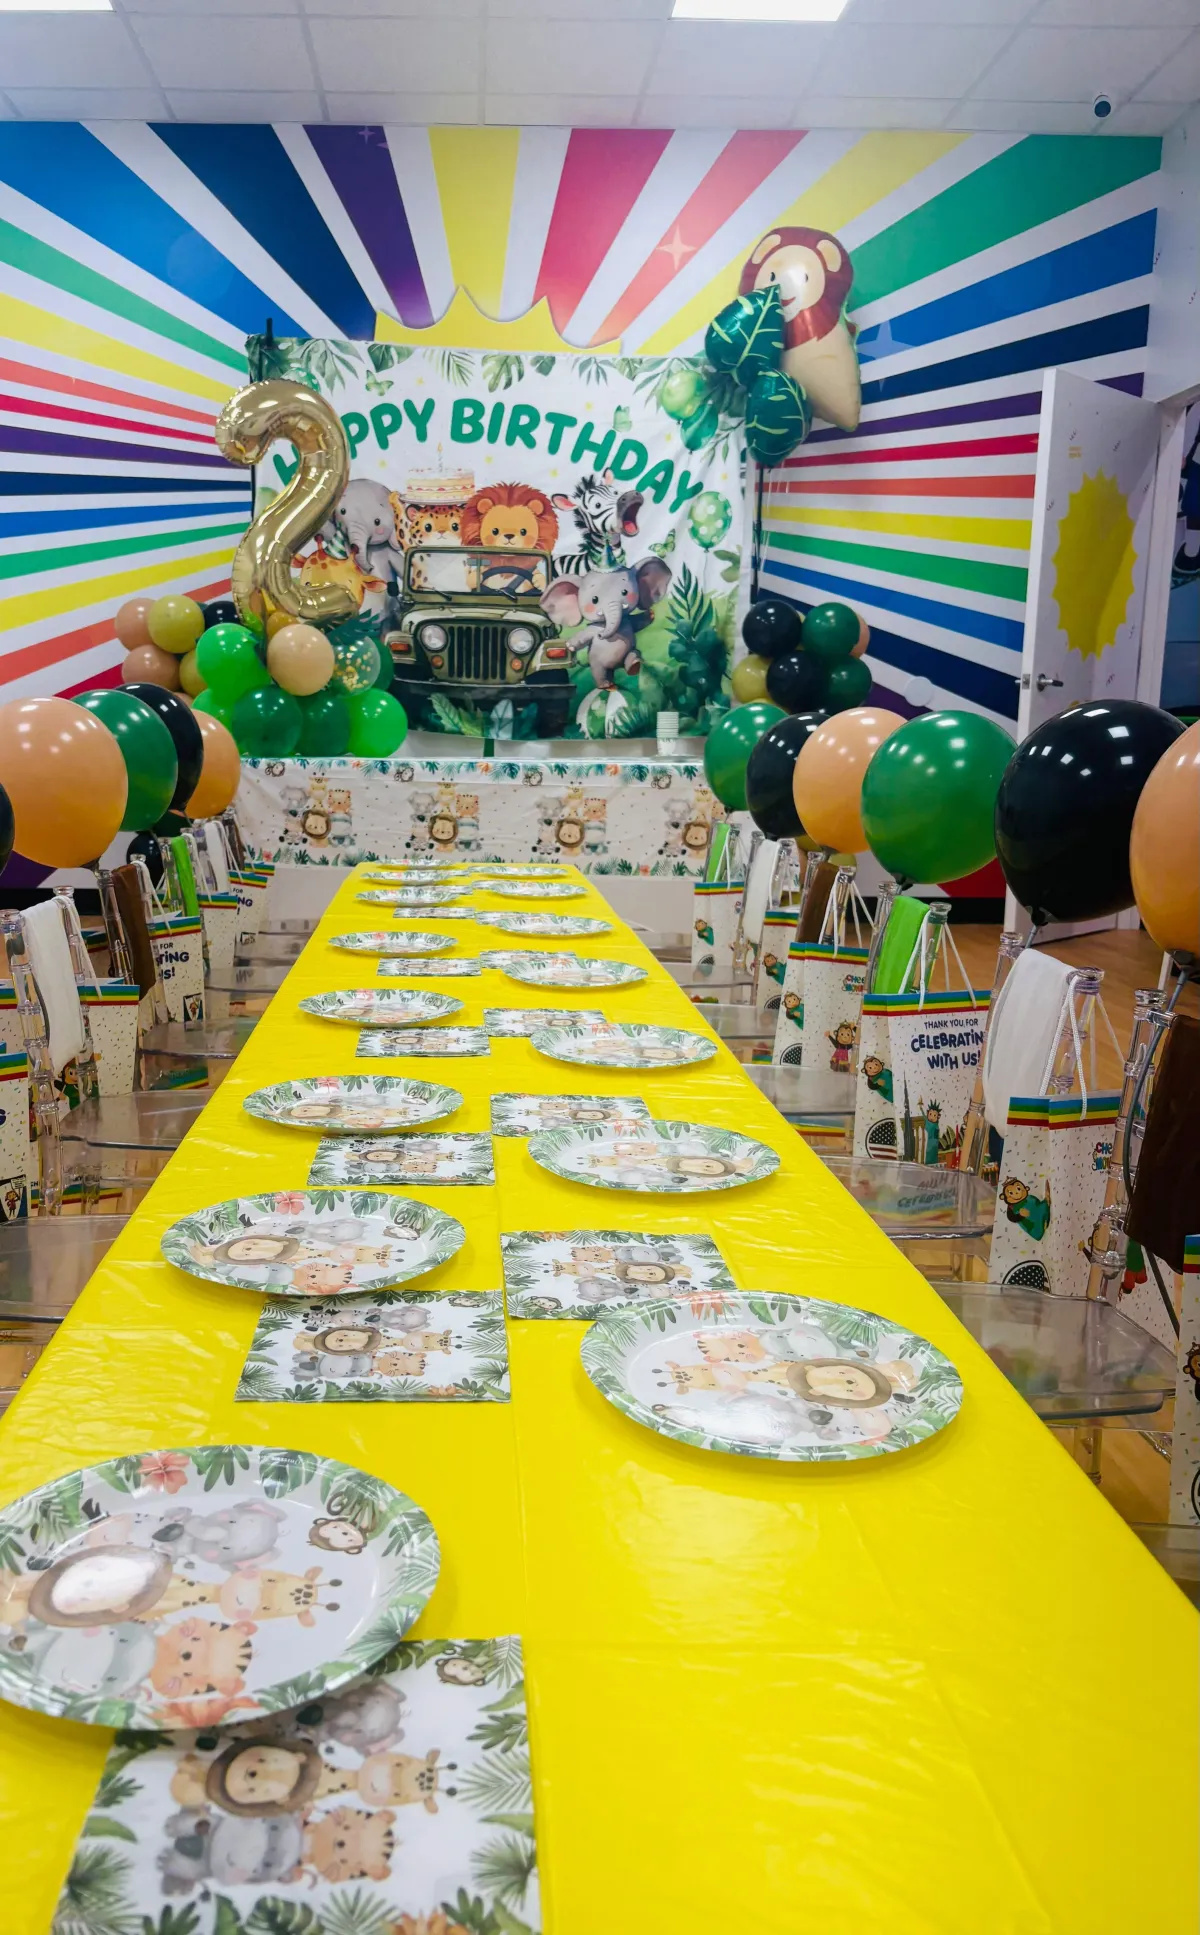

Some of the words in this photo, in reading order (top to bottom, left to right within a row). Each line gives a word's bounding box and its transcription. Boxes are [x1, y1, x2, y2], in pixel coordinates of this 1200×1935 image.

[273, 397, 436, 488] HPPY
[450, 398, 704, 514] BIRTHDAY
[160, 942, 174, 950] FOR
[924, 1020, 949, 1030] THANK
[950, 1019, 964, 1028] YOU
[965, 1018, 979, 1027] FOR
[911, 1029, 985, 1053] CELEBRATiN
[927, 1053, 959, 1070] WITH
[962, 1049, 981, 1066] US!
